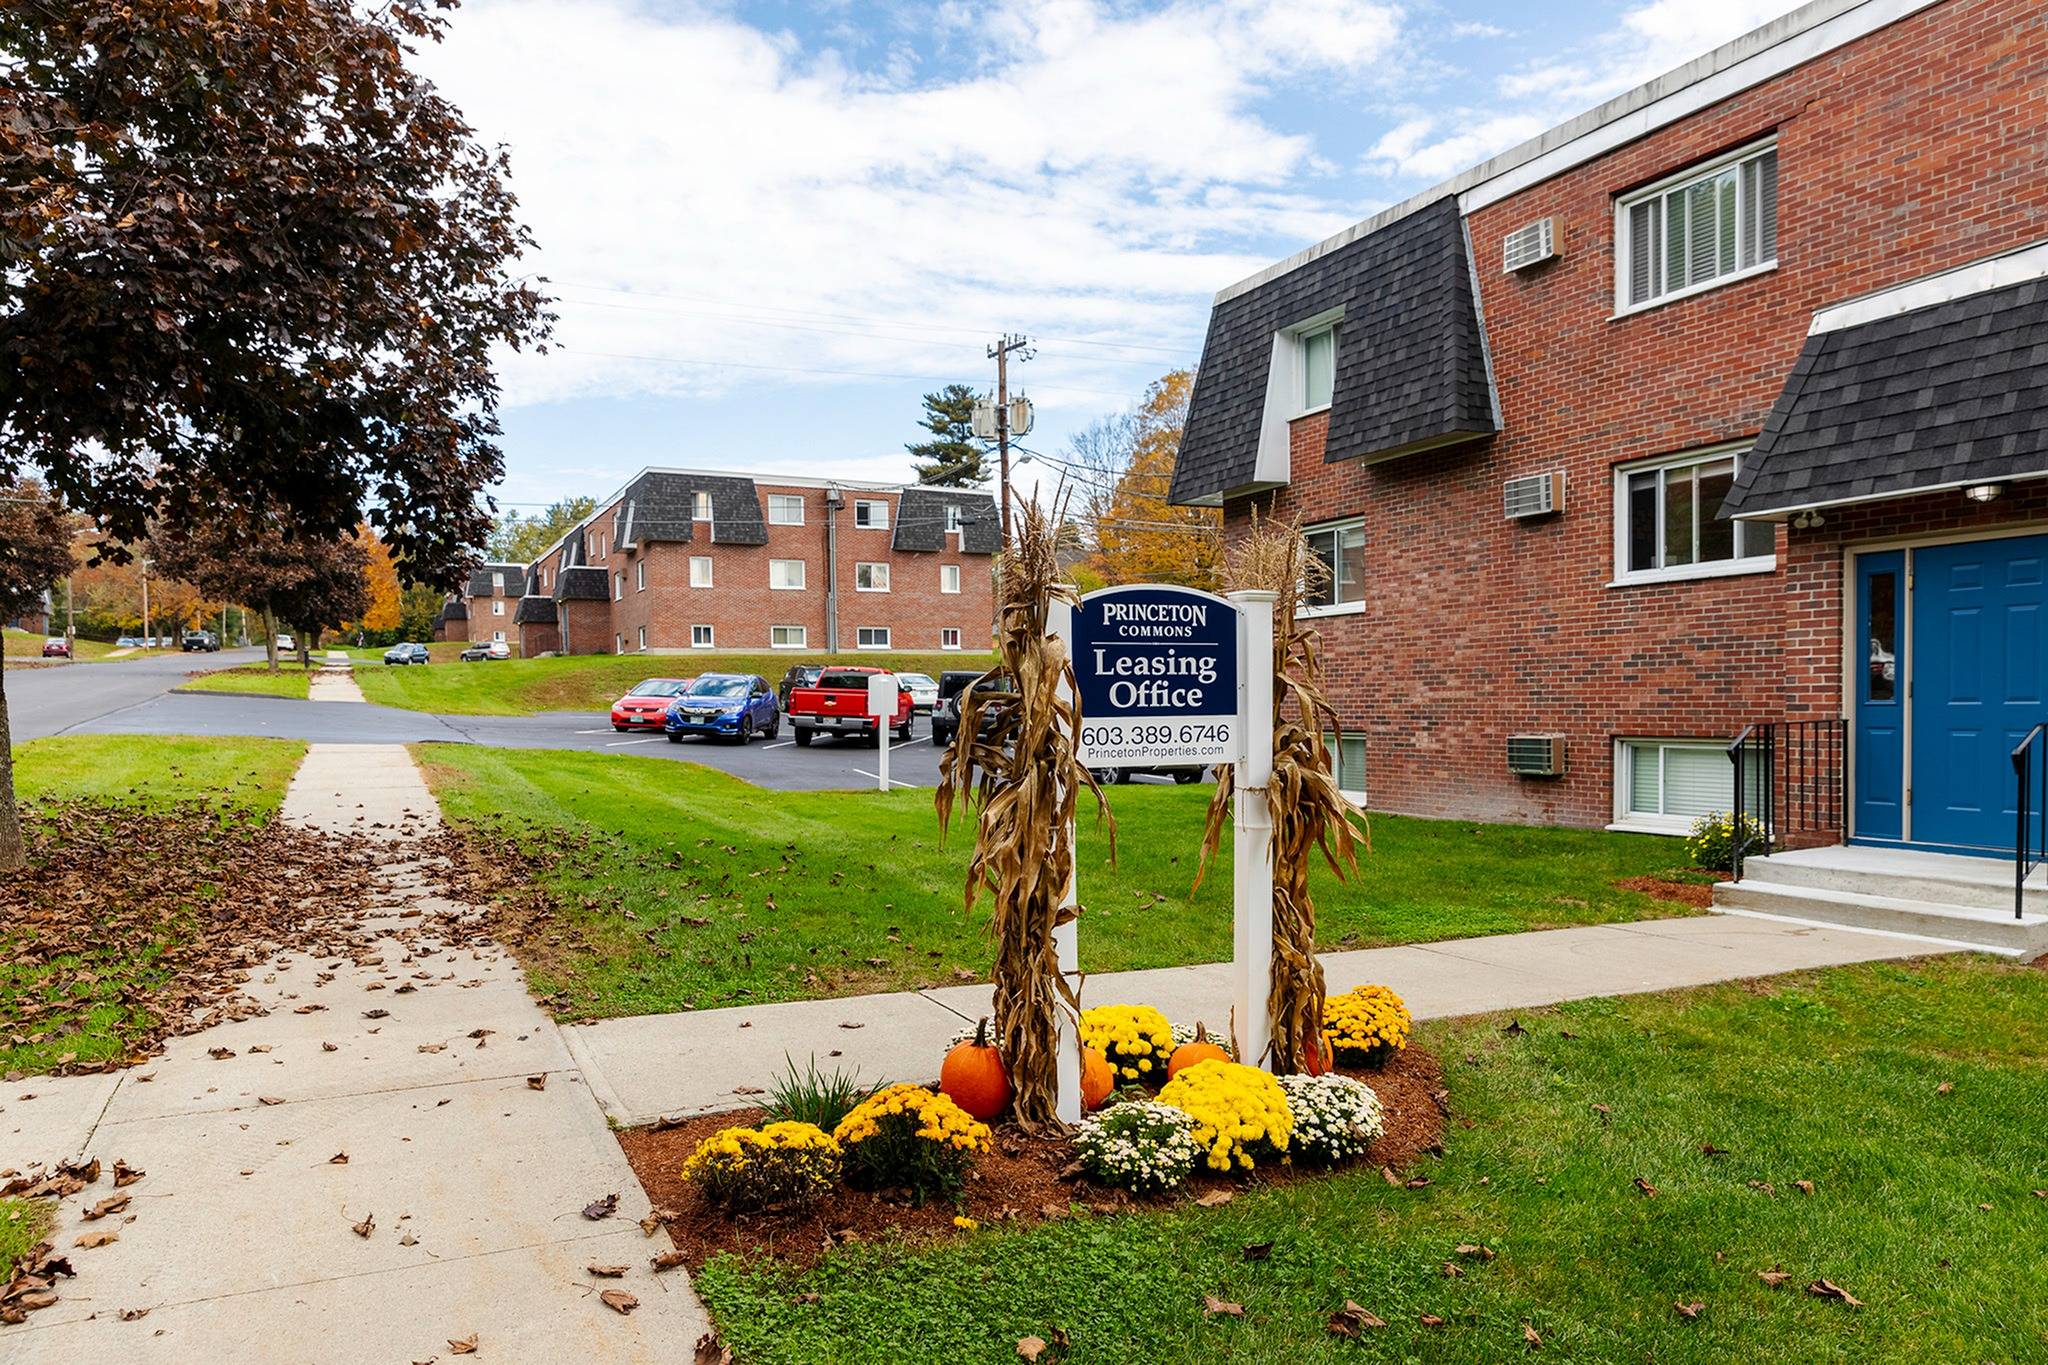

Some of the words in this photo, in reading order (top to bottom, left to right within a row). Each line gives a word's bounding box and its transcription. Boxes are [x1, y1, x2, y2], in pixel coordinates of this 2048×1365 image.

[1103, 603, 1207, 627] PRINCETON
[1119, 625, 1192, 637] COMMONS
[1093, 648, 1217, 684] Leasing
[1109, 680, 1203, 708] Office
[1081, 724, 1229, 746] 603.389.6746
[1087, 745, 1224, 759] PrincetonProperties.com
